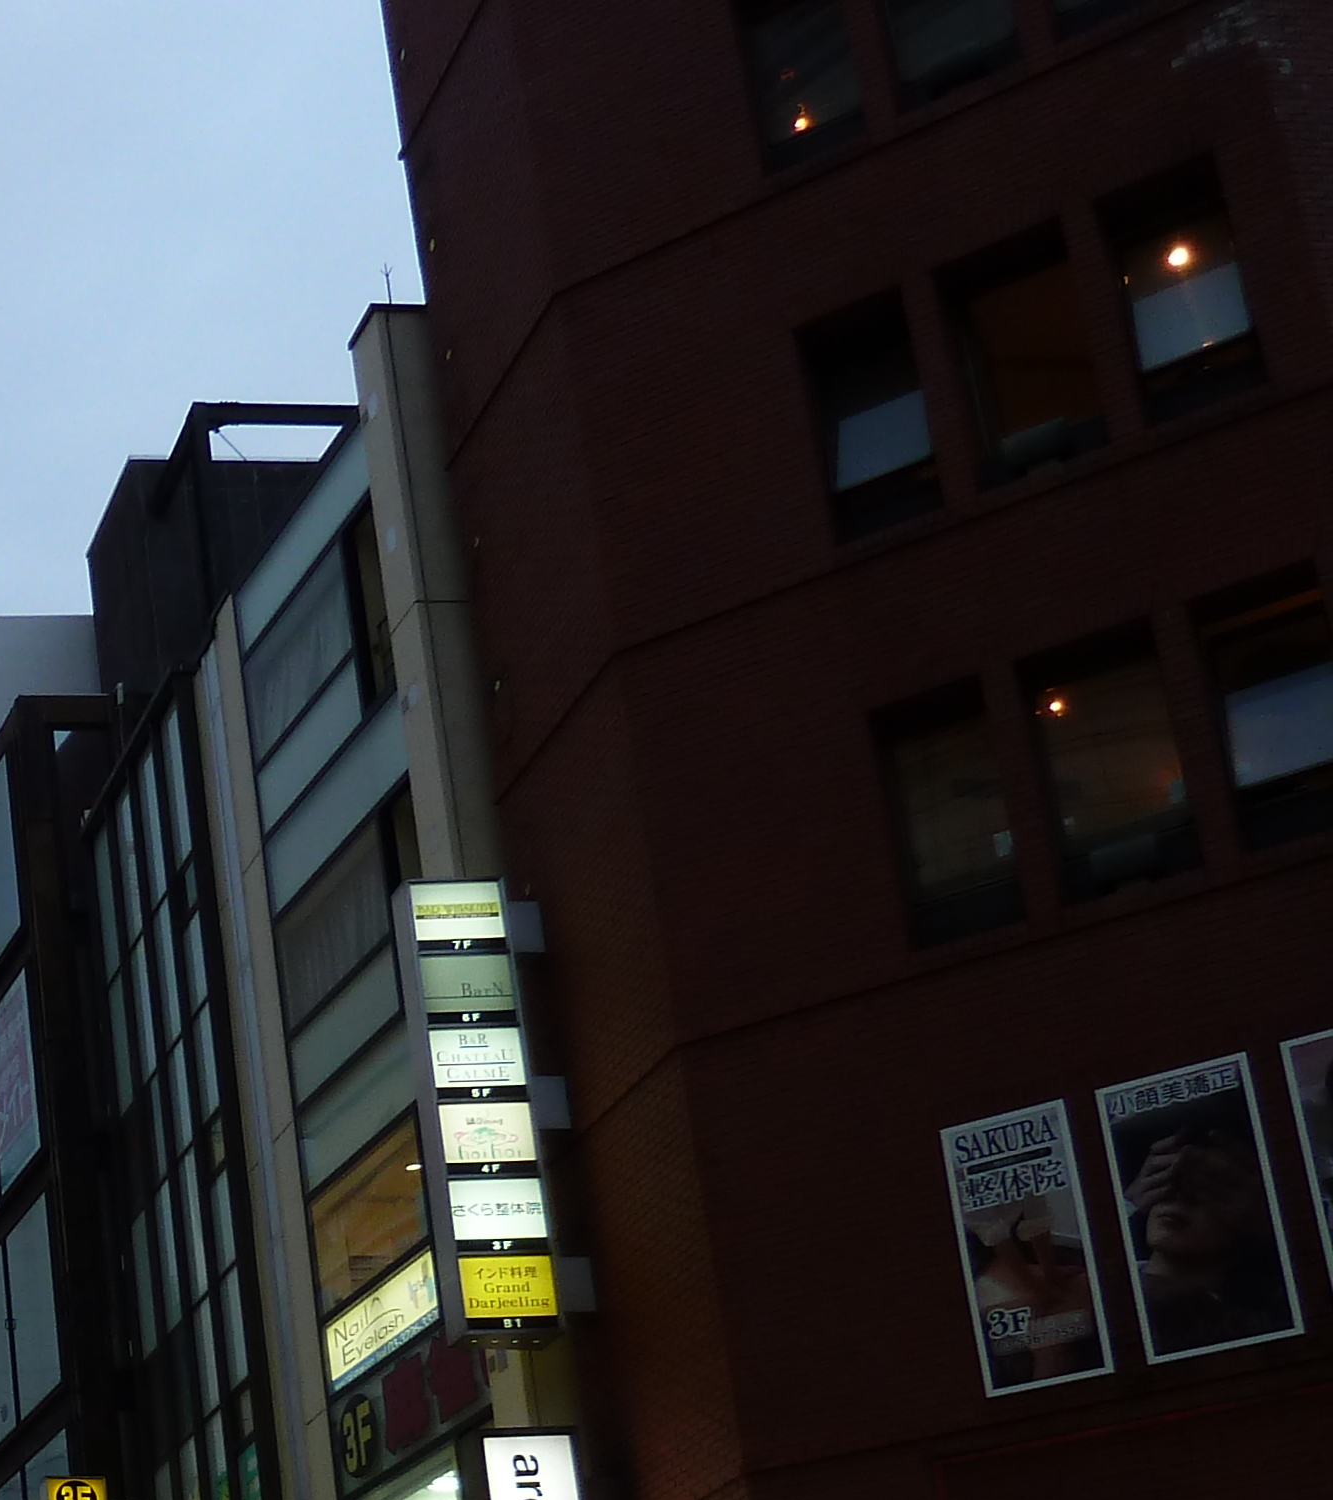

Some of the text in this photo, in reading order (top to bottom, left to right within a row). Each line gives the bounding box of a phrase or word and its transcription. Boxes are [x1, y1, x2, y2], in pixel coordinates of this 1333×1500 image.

[452, 941, 473, 951] 7F
[471, 1088, 492, 1098] 5F
[1107, 1065, 1239, 1118] 小顔美矯正
[954, 1114, 1059, 1168] SAKURA
[480, 1164, 501, 1175] 4F
[962, 1158, 1067, 1211] 整体院
[451, 1200, 543, 1219] さくら整体院
[491, 1240, 513, 1251] 3F
[472, 1265, 539, 1280] インド料理
[482, 1281, 531, 1294] Grand
[467, 1296, 551, 1311] Darjeeling
[333, 1307, 370, 1347] Nail
[988, 1308, 1030, 1338] 3F
[340, 1313, 405, 1367] Eyelash
[340, 1400, 374, 1474] 3F
